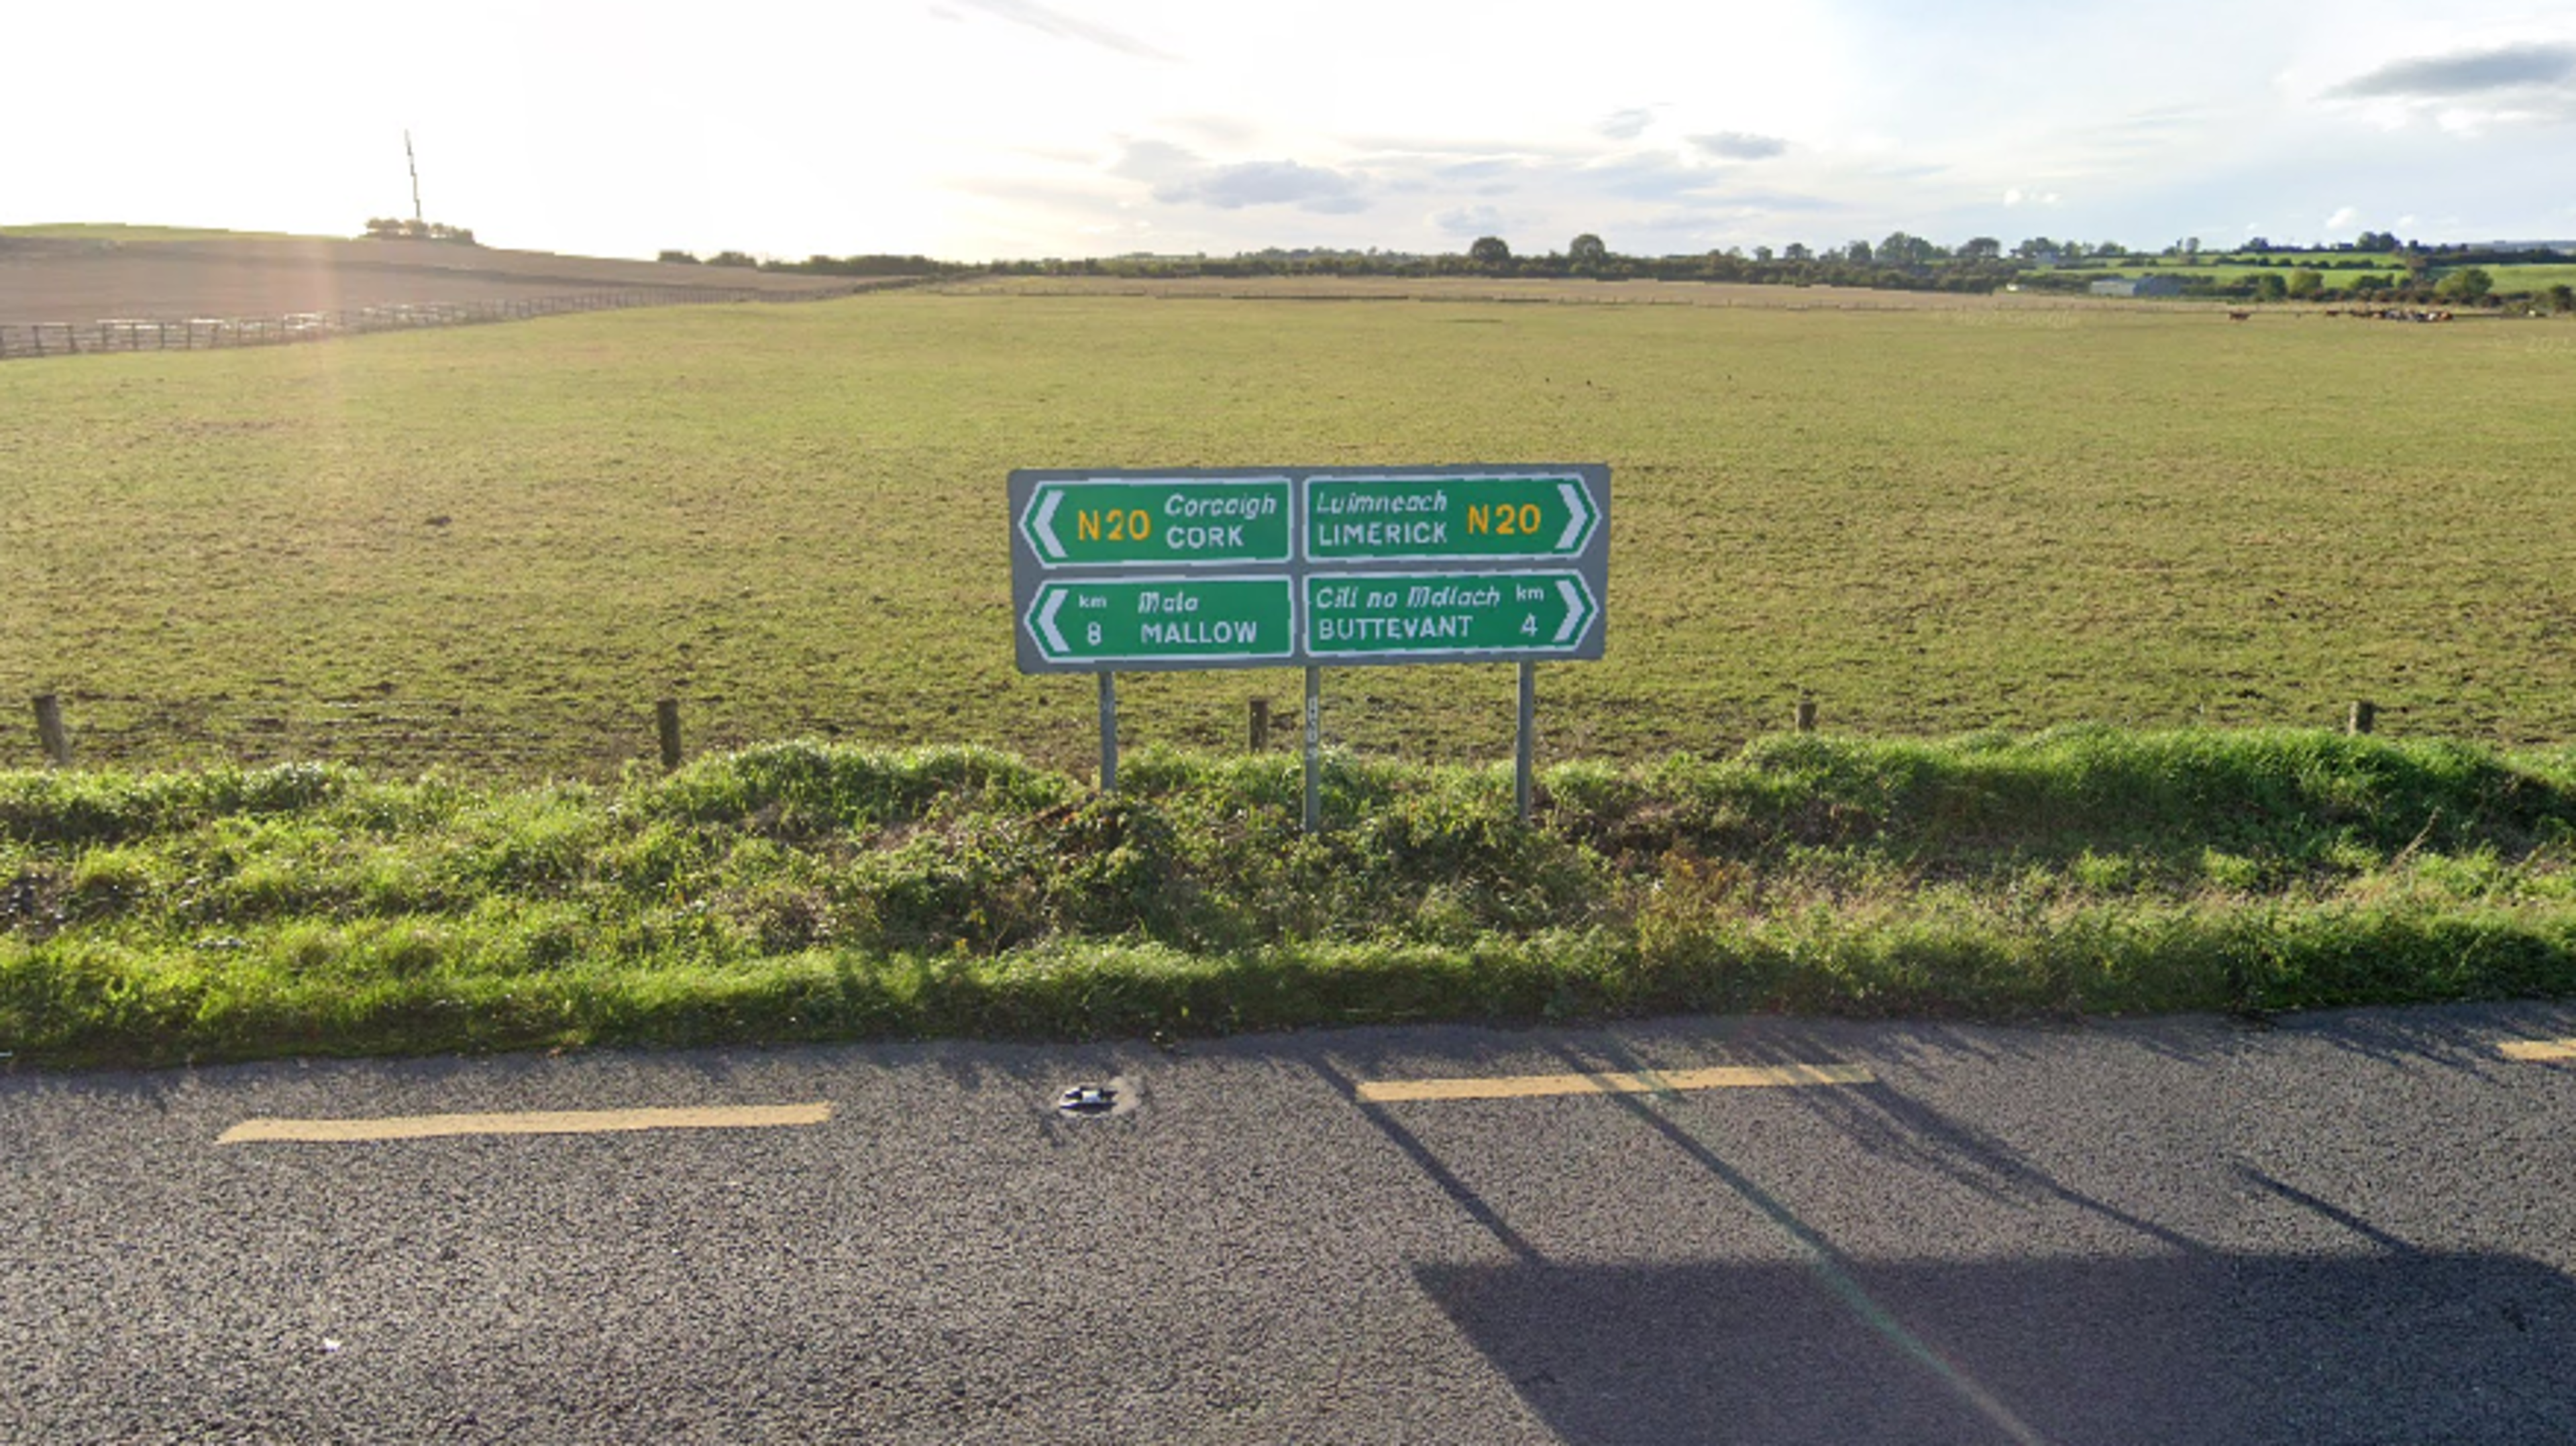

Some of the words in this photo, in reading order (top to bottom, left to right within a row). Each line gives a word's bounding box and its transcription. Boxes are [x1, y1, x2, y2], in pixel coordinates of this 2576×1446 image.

[1165, 494, 1277, 520] Corcaigh
[1318, 490, 1447, 512] Luimneach
[1079, 509, 1151, 541] N20
[1467, 504, 1541, 535] N20
[1167, 526, 1244, 549] CORK
[1319, 522, 1448, 546] LIMERICK
[1079, 594, 1106, 608] km
[1138, 592, 1199, 613] Mala
[1317, 586, 1358, 608] Cill
[1516, 585, 1544, 601] km
[1087, 622, 1102, 645] 8
[1142, 622, 1256, 643] MALLOW
[1319, 616, 1473, 641] BUTTEVANT
[1521, 614, 1538, 636] 4
